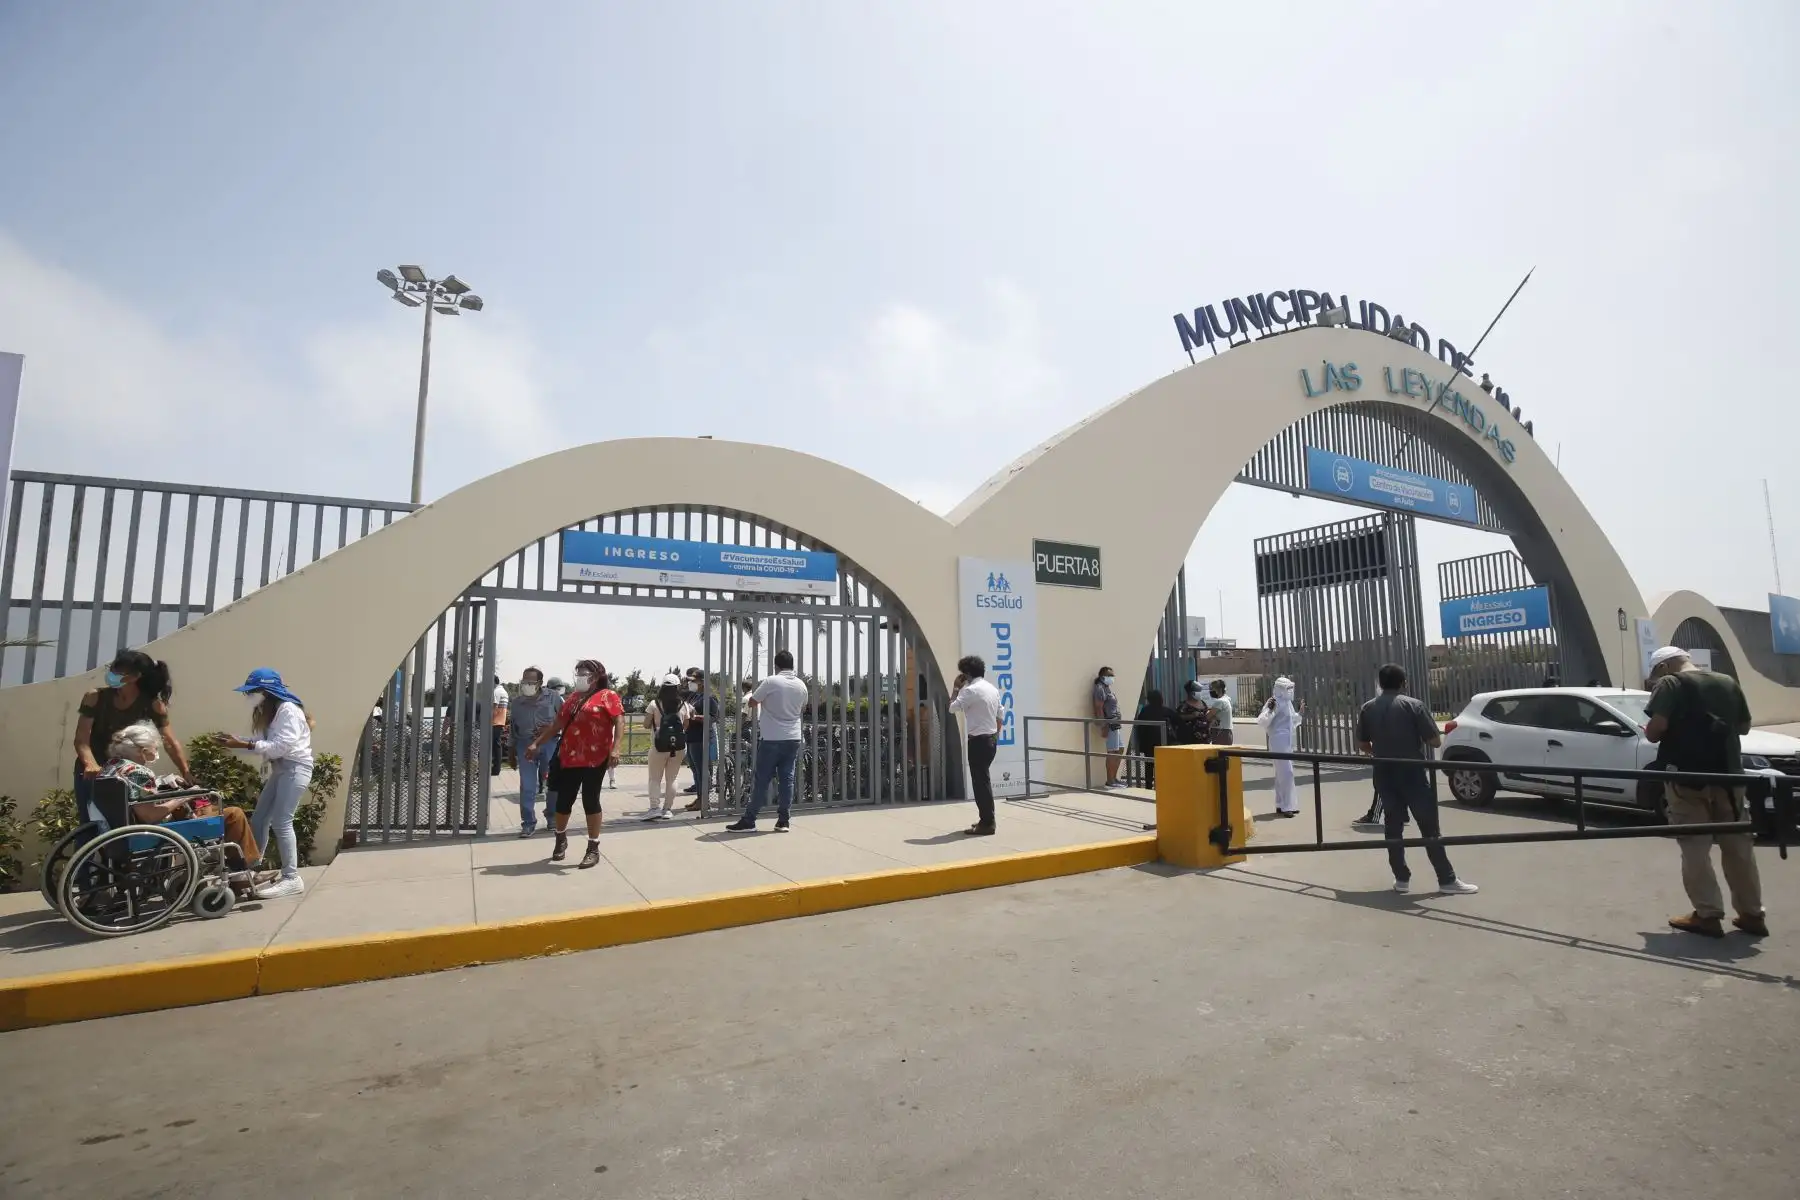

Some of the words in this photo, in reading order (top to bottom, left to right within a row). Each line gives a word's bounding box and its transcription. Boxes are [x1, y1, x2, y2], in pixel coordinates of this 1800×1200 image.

[1173, 289, 1431, 354] MUNICIPALIDAD
[1439, 338, 1475, 378] DE
[1301, 362, 1363, 398] LAS
[1383, 365, 1516, 464] LEYENDAS
[604, 546, 680, 562] INGRESO
[722, 552, 805, 566] #VacunarseEsSalud
[763, 565, 795, 574] COVID-19
[1036, 553, 1091, 576] PUERTA
[1091, 558, 1100, 577] 8
[976, 594, 1023, 610] EsSalud
[1463, 612, 1522, 628] INGRESO
